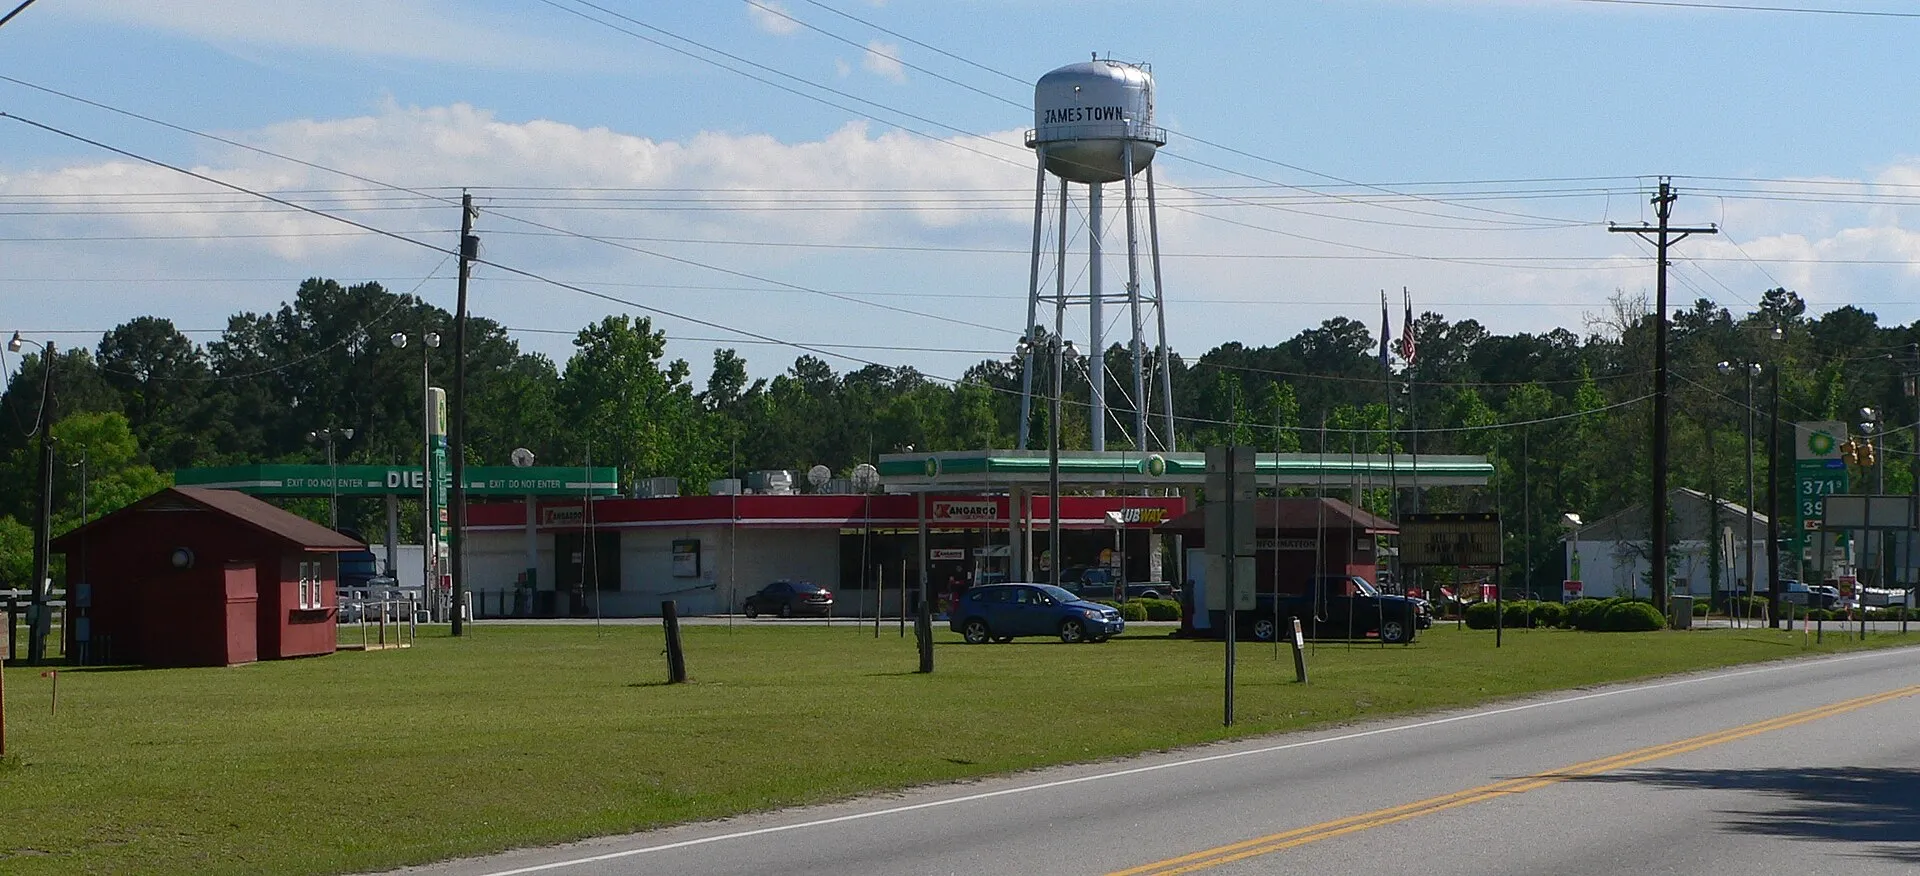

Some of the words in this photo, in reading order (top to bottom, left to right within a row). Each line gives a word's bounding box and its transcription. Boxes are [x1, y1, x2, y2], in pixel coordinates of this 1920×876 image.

[287, 479, 303, 487] EXIT
[308, 479, 318, 487] DO
[321, 479, 335, 487] NOT
[338, 479, 363, 487] ENTER
[489, 480, 504, 489] EXIT
[509, 480, 519, 488] DO
[522, 480, 535, 488] NOT
[538, 480, 560, 488] ENTER
[935, 503, 996, 518] KANGAROO
[1256, 540, 1316, 549] NFORMATION
